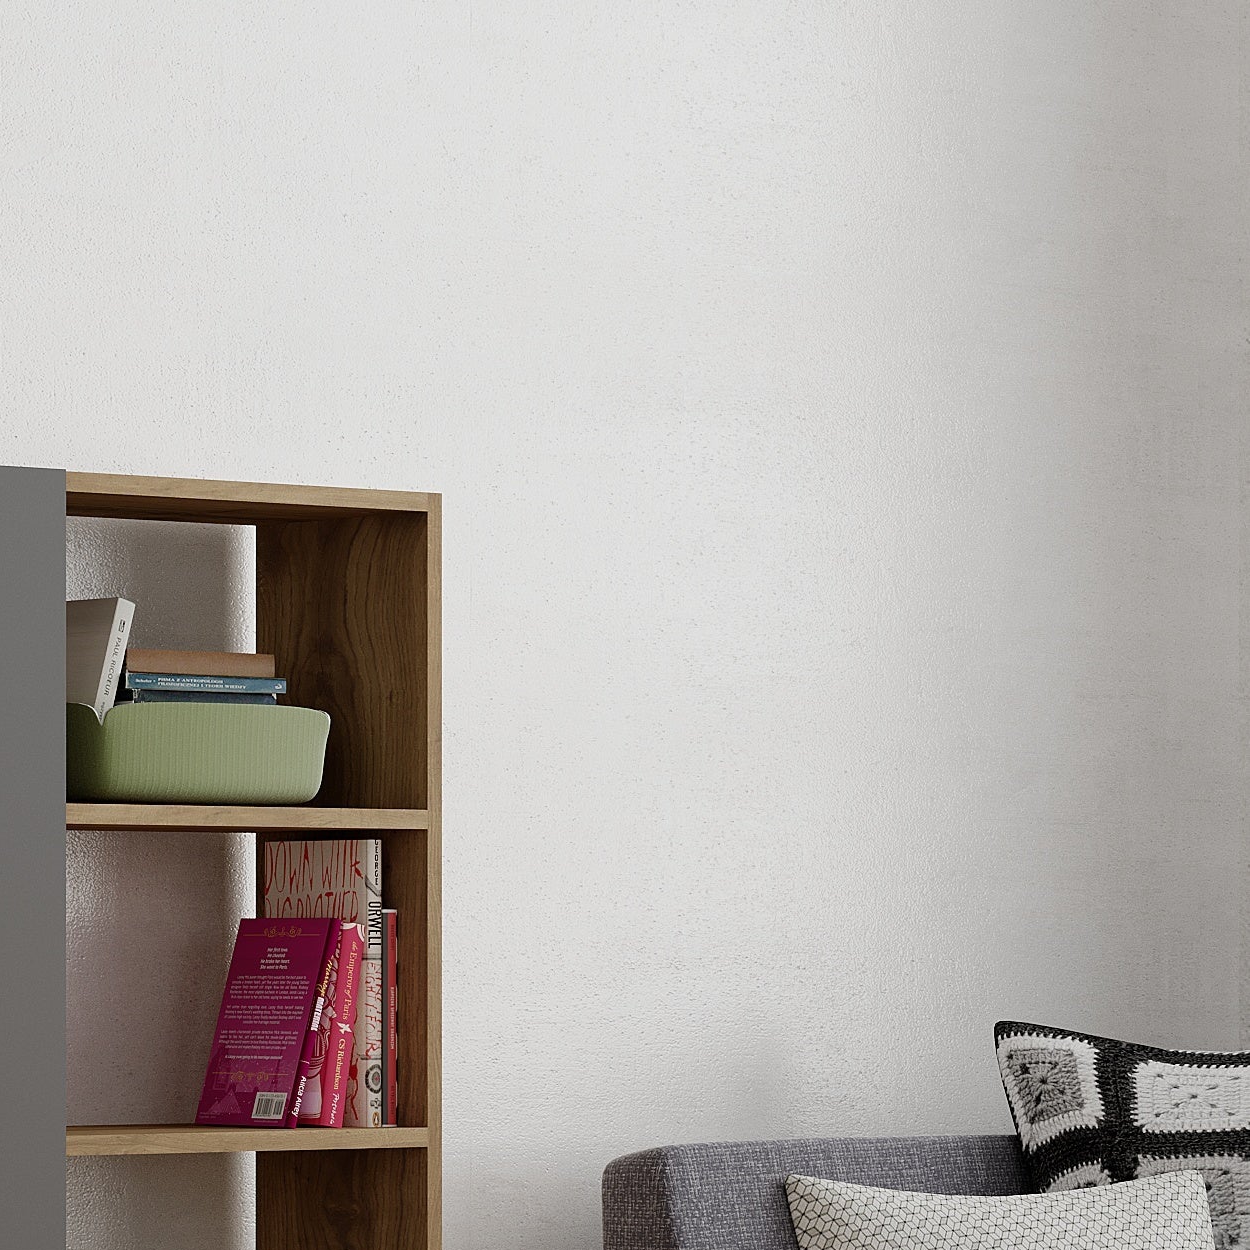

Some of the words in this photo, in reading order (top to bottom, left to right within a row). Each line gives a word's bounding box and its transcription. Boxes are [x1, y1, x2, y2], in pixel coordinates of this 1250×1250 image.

[112, 637, 122, 657] PAUL
[368, 901, 381, 948] ORWELL
[345, 952, 356, 989] Emperor
[344, 989, 352, 999] of
[342, 999, 351, 1020] Paris
[338, 1039, 346, 1050] CS
[333, 1051, 344, 1090] Richardson
